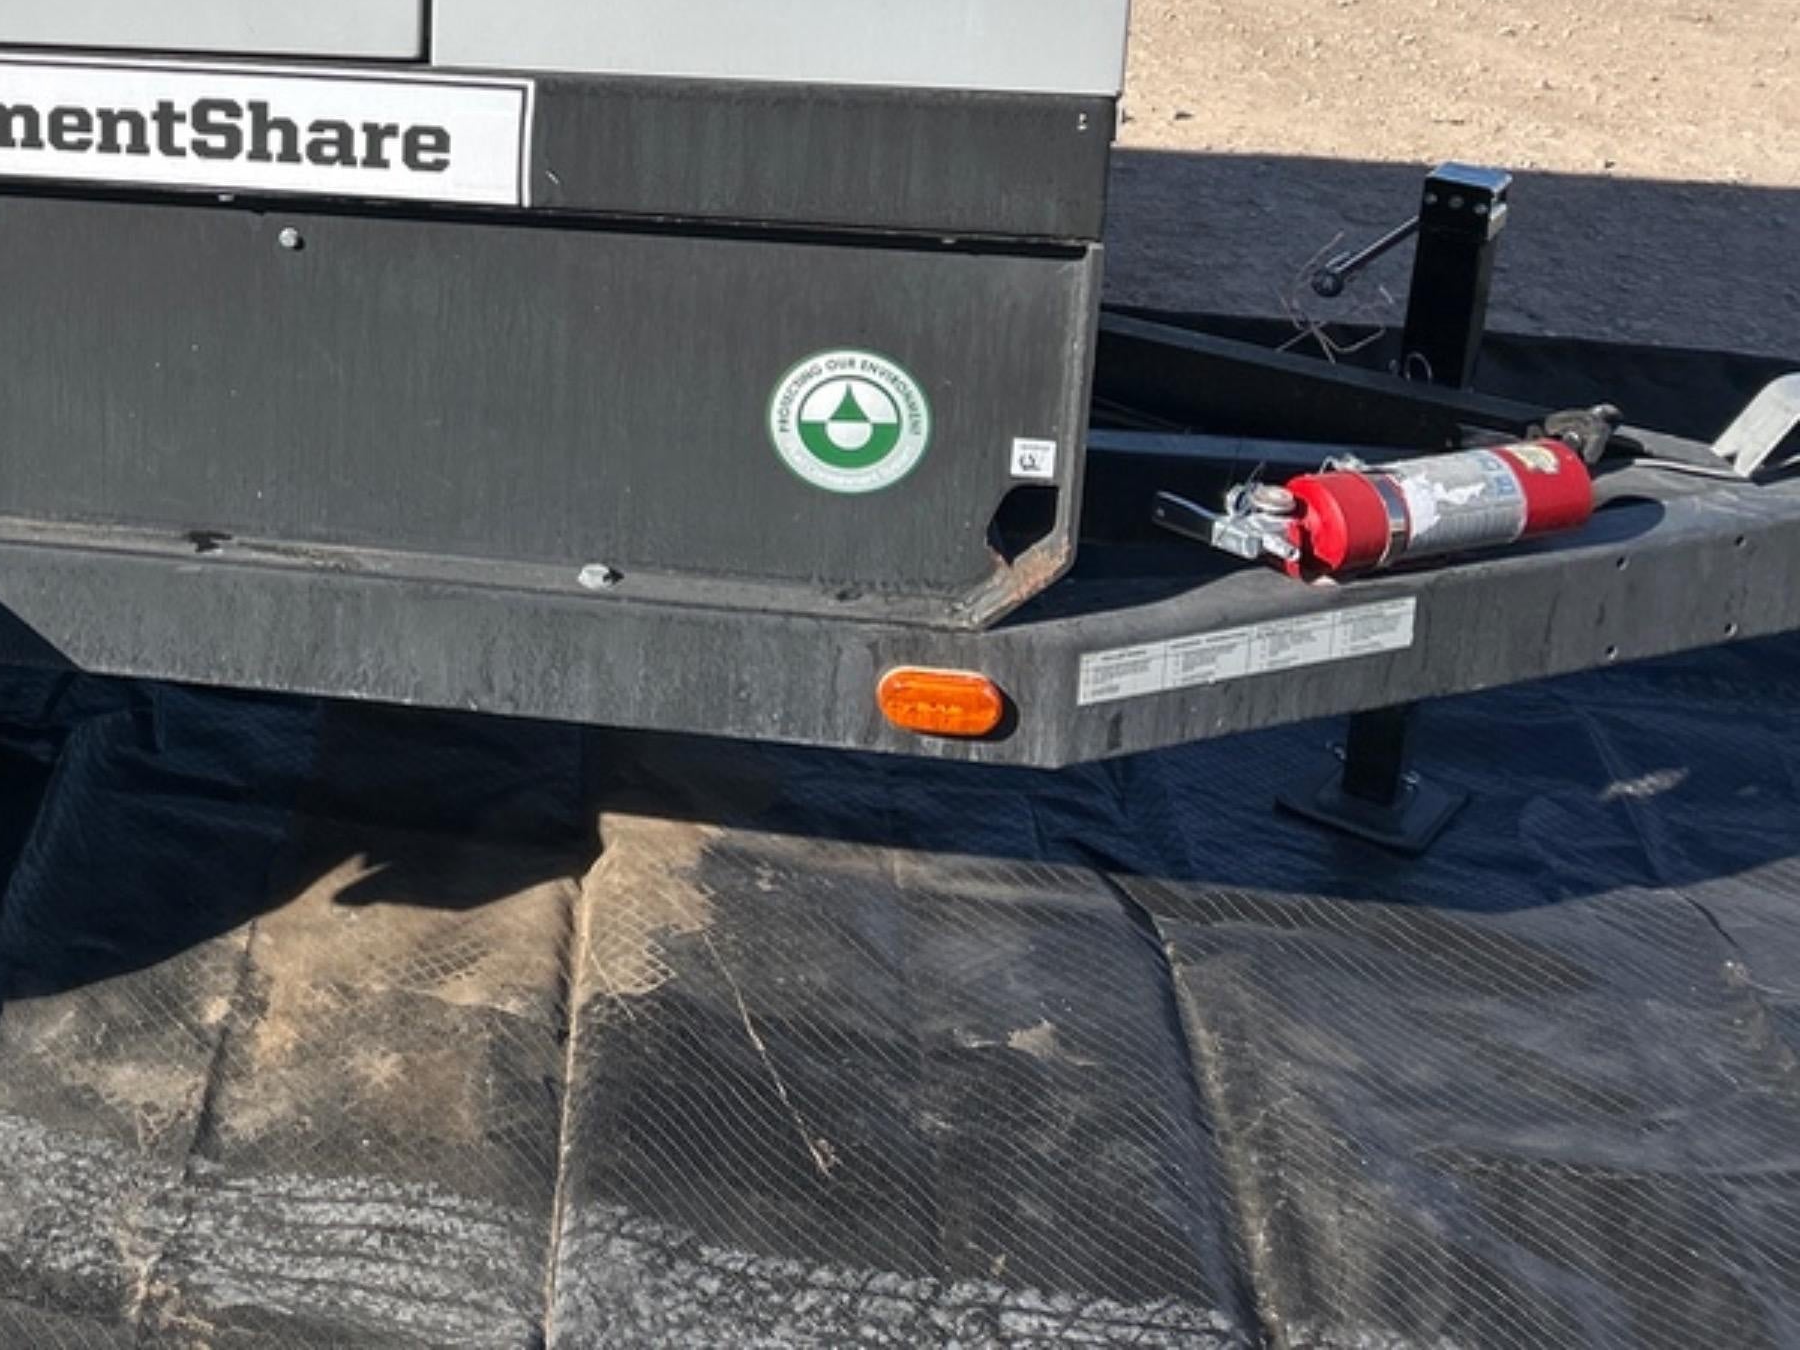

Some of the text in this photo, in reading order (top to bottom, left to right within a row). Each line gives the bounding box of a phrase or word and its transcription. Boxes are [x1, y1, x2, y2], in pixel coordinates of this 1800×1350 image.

[778, 357, 922, 436] PROTECTING OUR ENVIRONMENT
